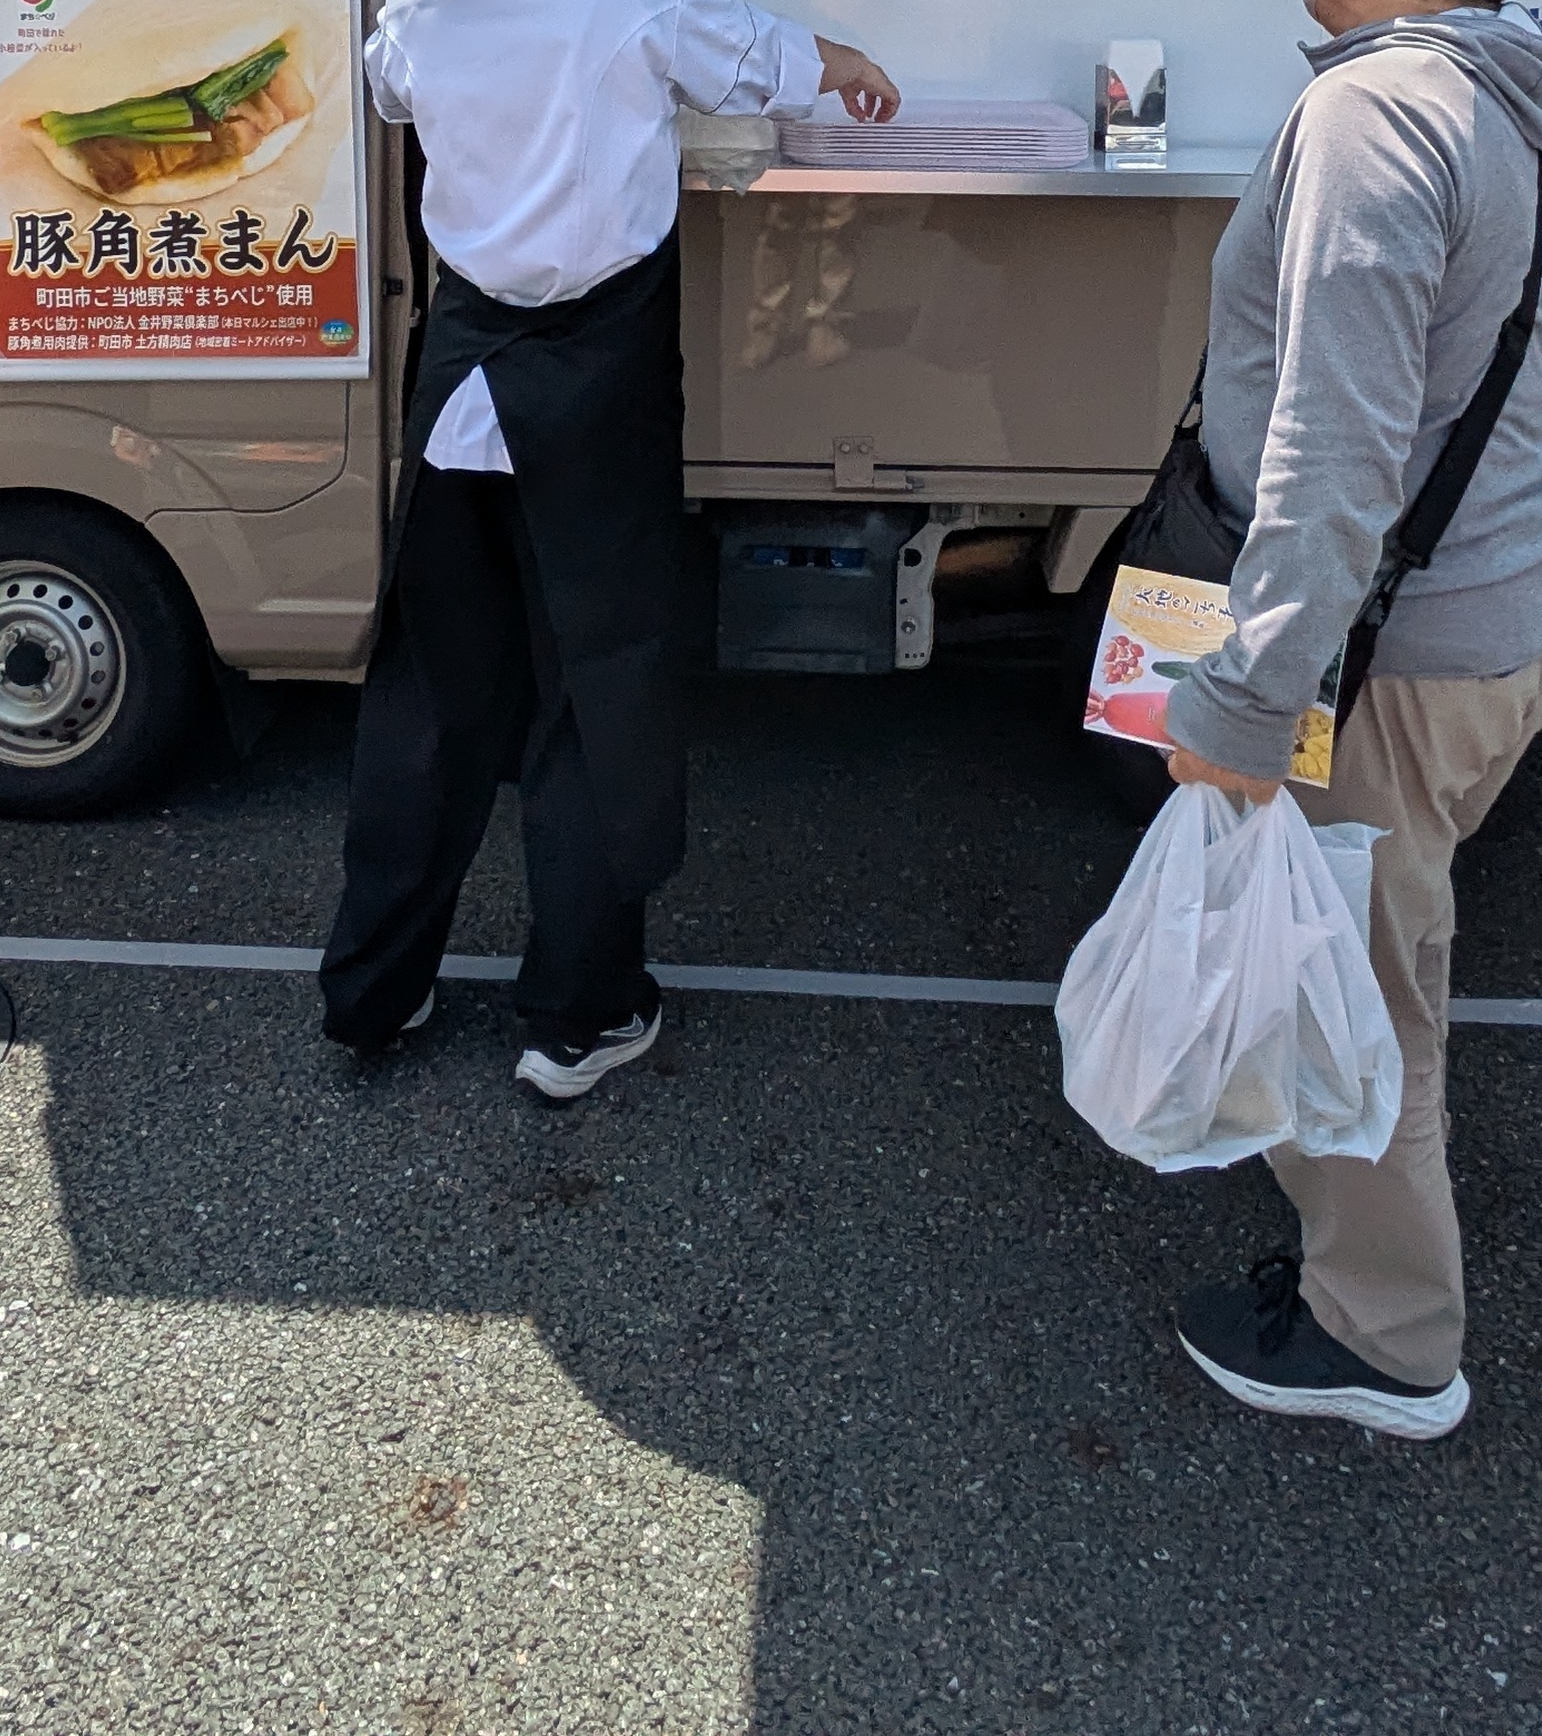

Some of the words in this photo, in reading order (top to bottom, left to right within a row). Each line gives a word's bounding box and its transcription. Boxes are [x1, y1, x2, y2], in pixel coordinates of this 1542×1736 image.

[12, 208, 338, 275] 豚角煮まん
